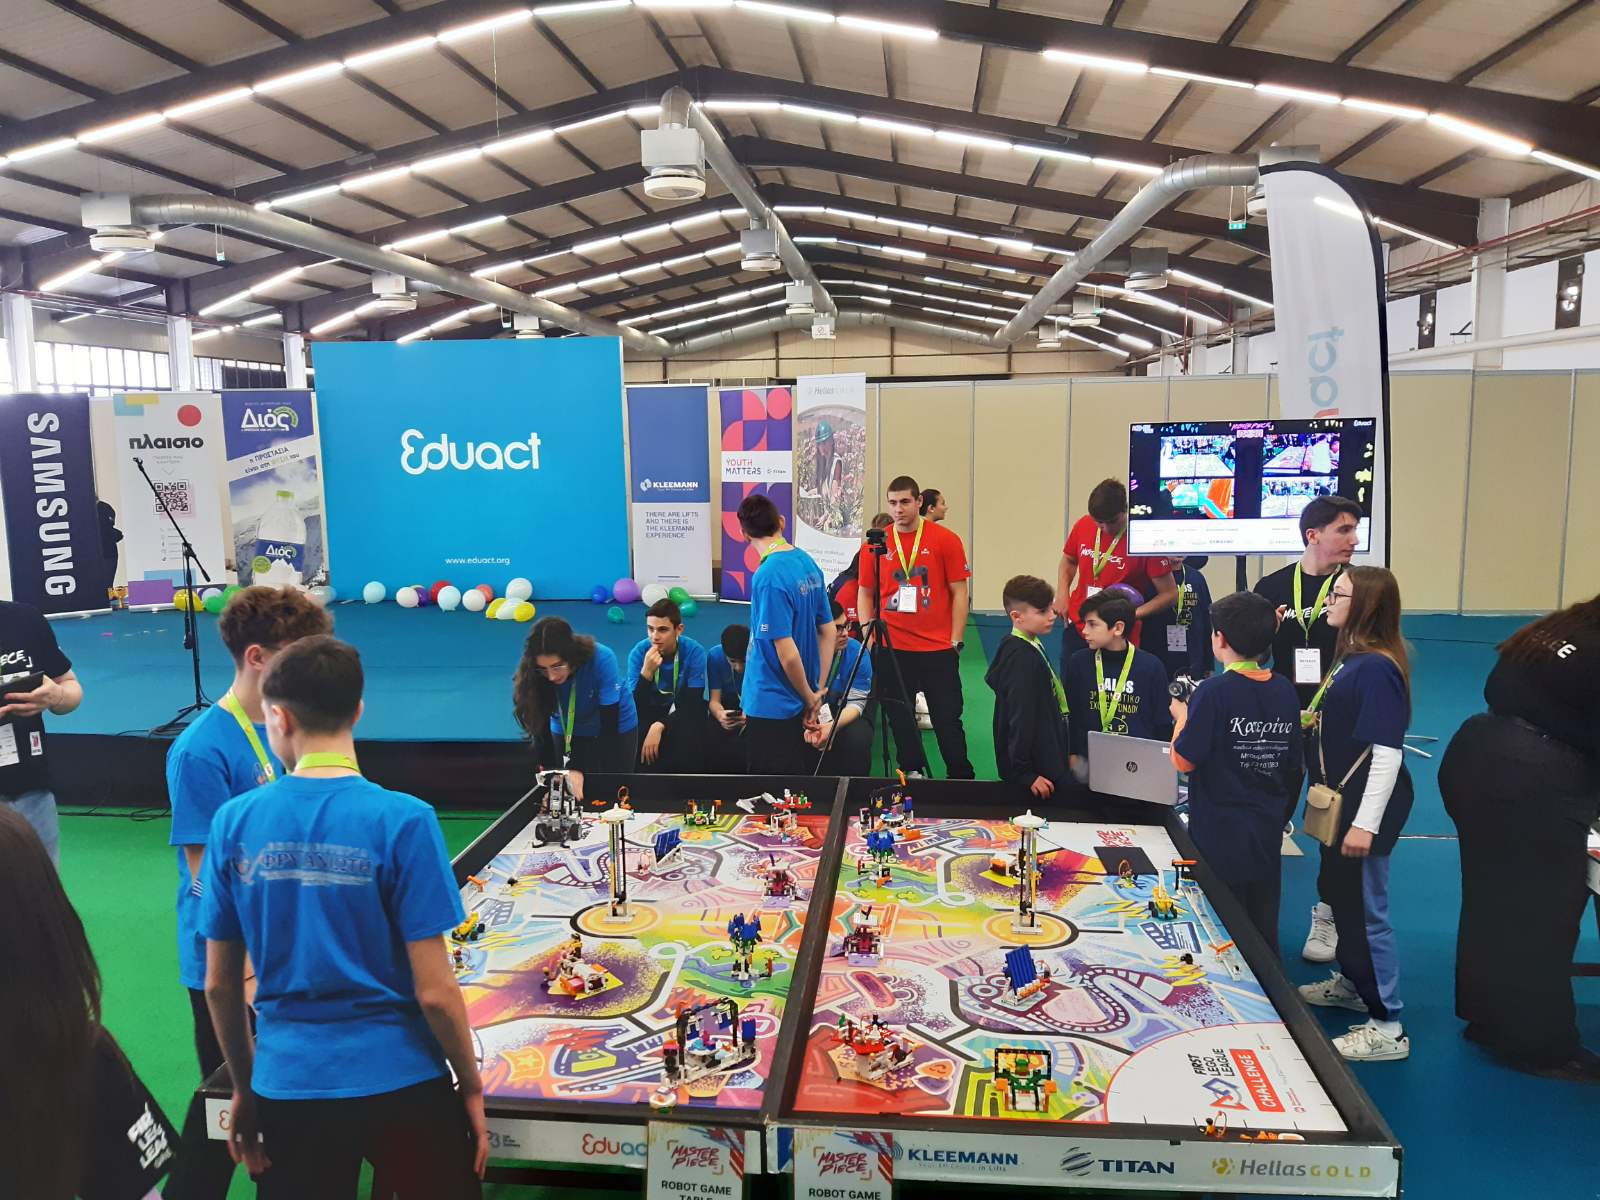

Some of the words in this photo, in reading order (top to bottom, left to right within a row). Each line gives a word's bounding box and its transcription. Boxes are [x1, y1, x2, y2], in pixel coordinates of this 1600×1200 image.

[400, 428, 541, 475] Eduact
[726, 458, 753, 467] YOUTH
[725, 467, 761, 475] MATTERS
[27, 412, 76, 596] SAMSUNG
[444, 555, 511, 566] www.eduact.org
[1126, 761, 1138, 773] hp
[1187, 1053, 1207, 1076] FIRST
[1203, 1056, 1222, 1077] LEGO
[1212, 1048, 1236, 1077] LEAGUE
[1238, 1053, 1277, 1108] CHALLENGE
[582, 1133, 648, 1156] Eduac
[670, 1144, 720, 1160] MASTER
[672, 1157, 720, 1170] PIECE
[817, 1151, 867, 1166] MASTER
[908, 1149, 1018, 1166] KLEEMANN
[819, 1163, 867, 1177] PIECE
[1098, 1159, 1175, 1174] TITAN
[1240, 1159, 1306, 1177] Hellas
[1310, 1165, 1371, 1178] GOLD
[661, 1180, 698, 1192] ROBOT
[700, 1184, 732, 1195] GAME
[808, 1188, 846, 1198] ROBOT
[848, 1190, 881, 1200] GAME
